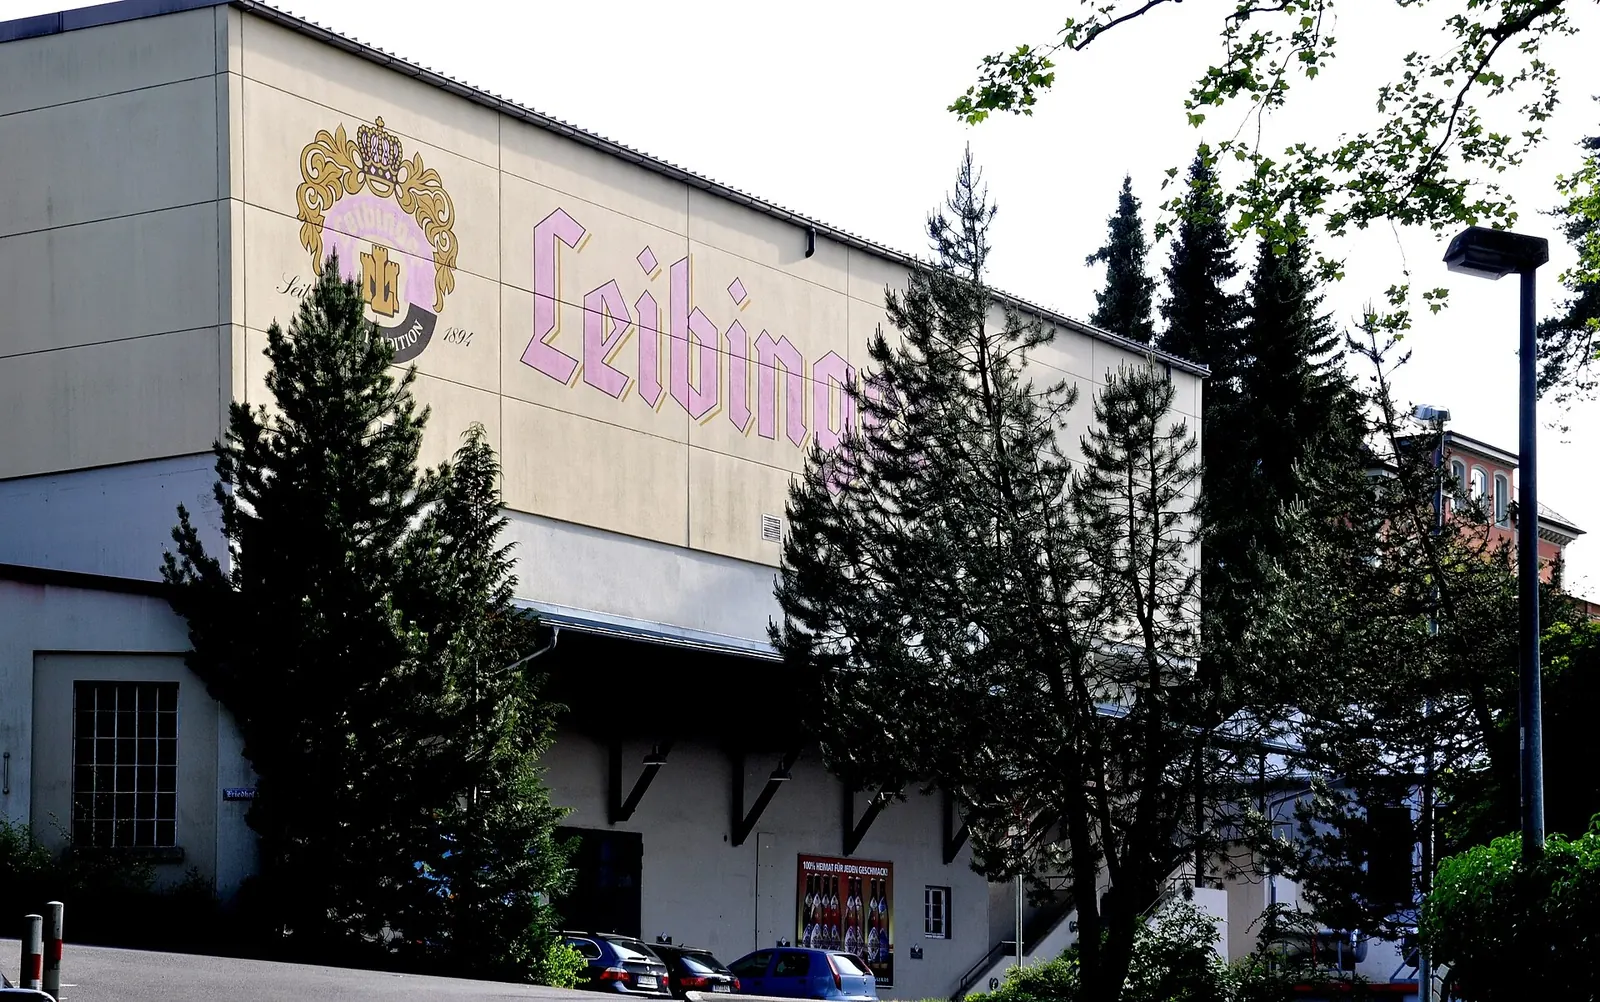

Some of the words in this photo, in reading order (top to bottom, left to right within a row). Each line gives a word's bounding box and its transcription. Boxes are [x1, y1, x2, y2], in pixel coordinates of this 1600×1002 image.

[443, 326, 474, 347] 1894
[803, 861, 815, 870] 100%
[816, 862, 834, 871] HEIMAT
[834, 862, 843, 872] FÜR
[844, 864, 858, 873] JEDEN
